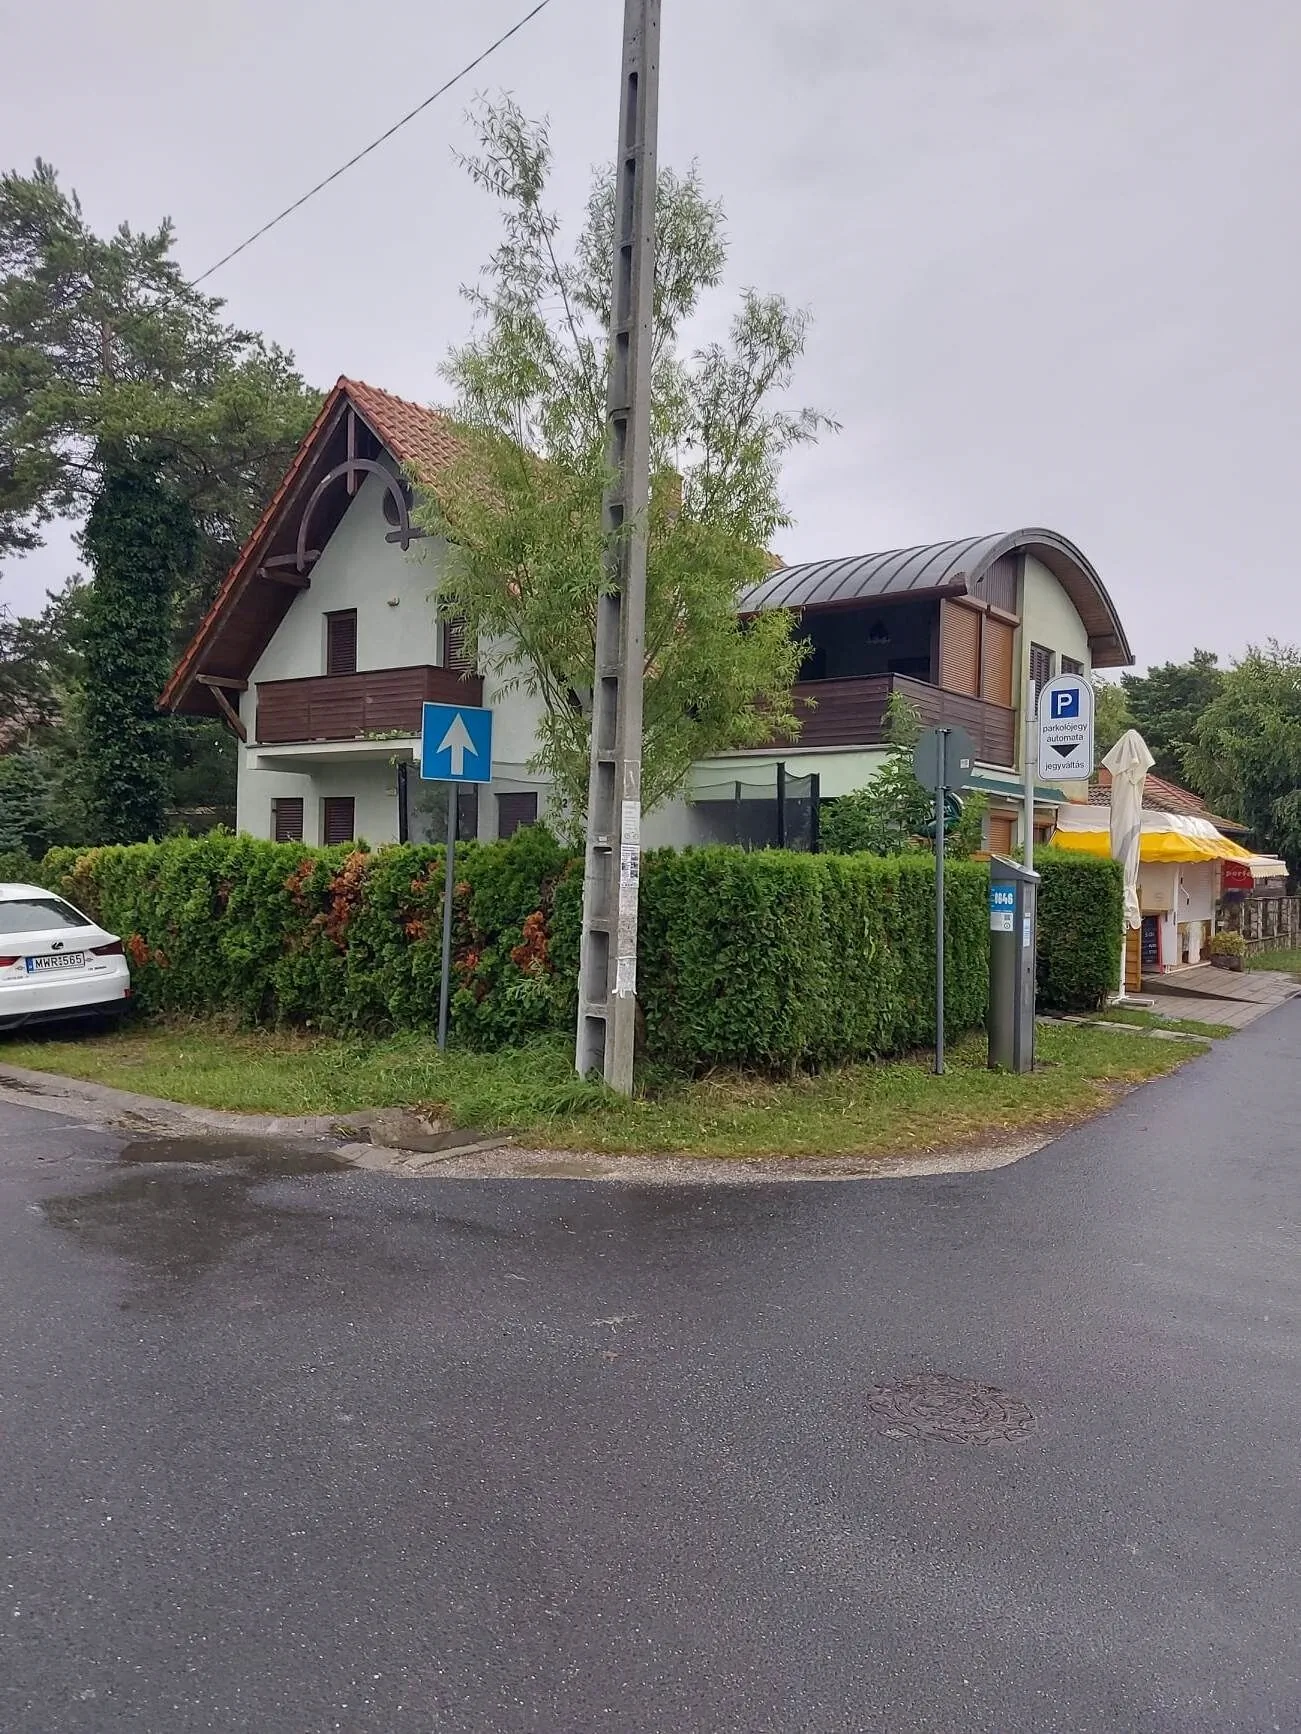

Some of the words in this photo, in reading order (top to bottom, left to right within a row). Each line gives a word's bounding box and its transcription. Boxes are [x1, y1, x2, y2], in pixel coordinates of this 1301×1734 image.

[1057, 693, 1073, 715] P
[1043, 723, 1088, 733] parkolójegy
[1046, 734, 1084, 743] automata
[1045, 761, 1085, 771] jegyváltás
